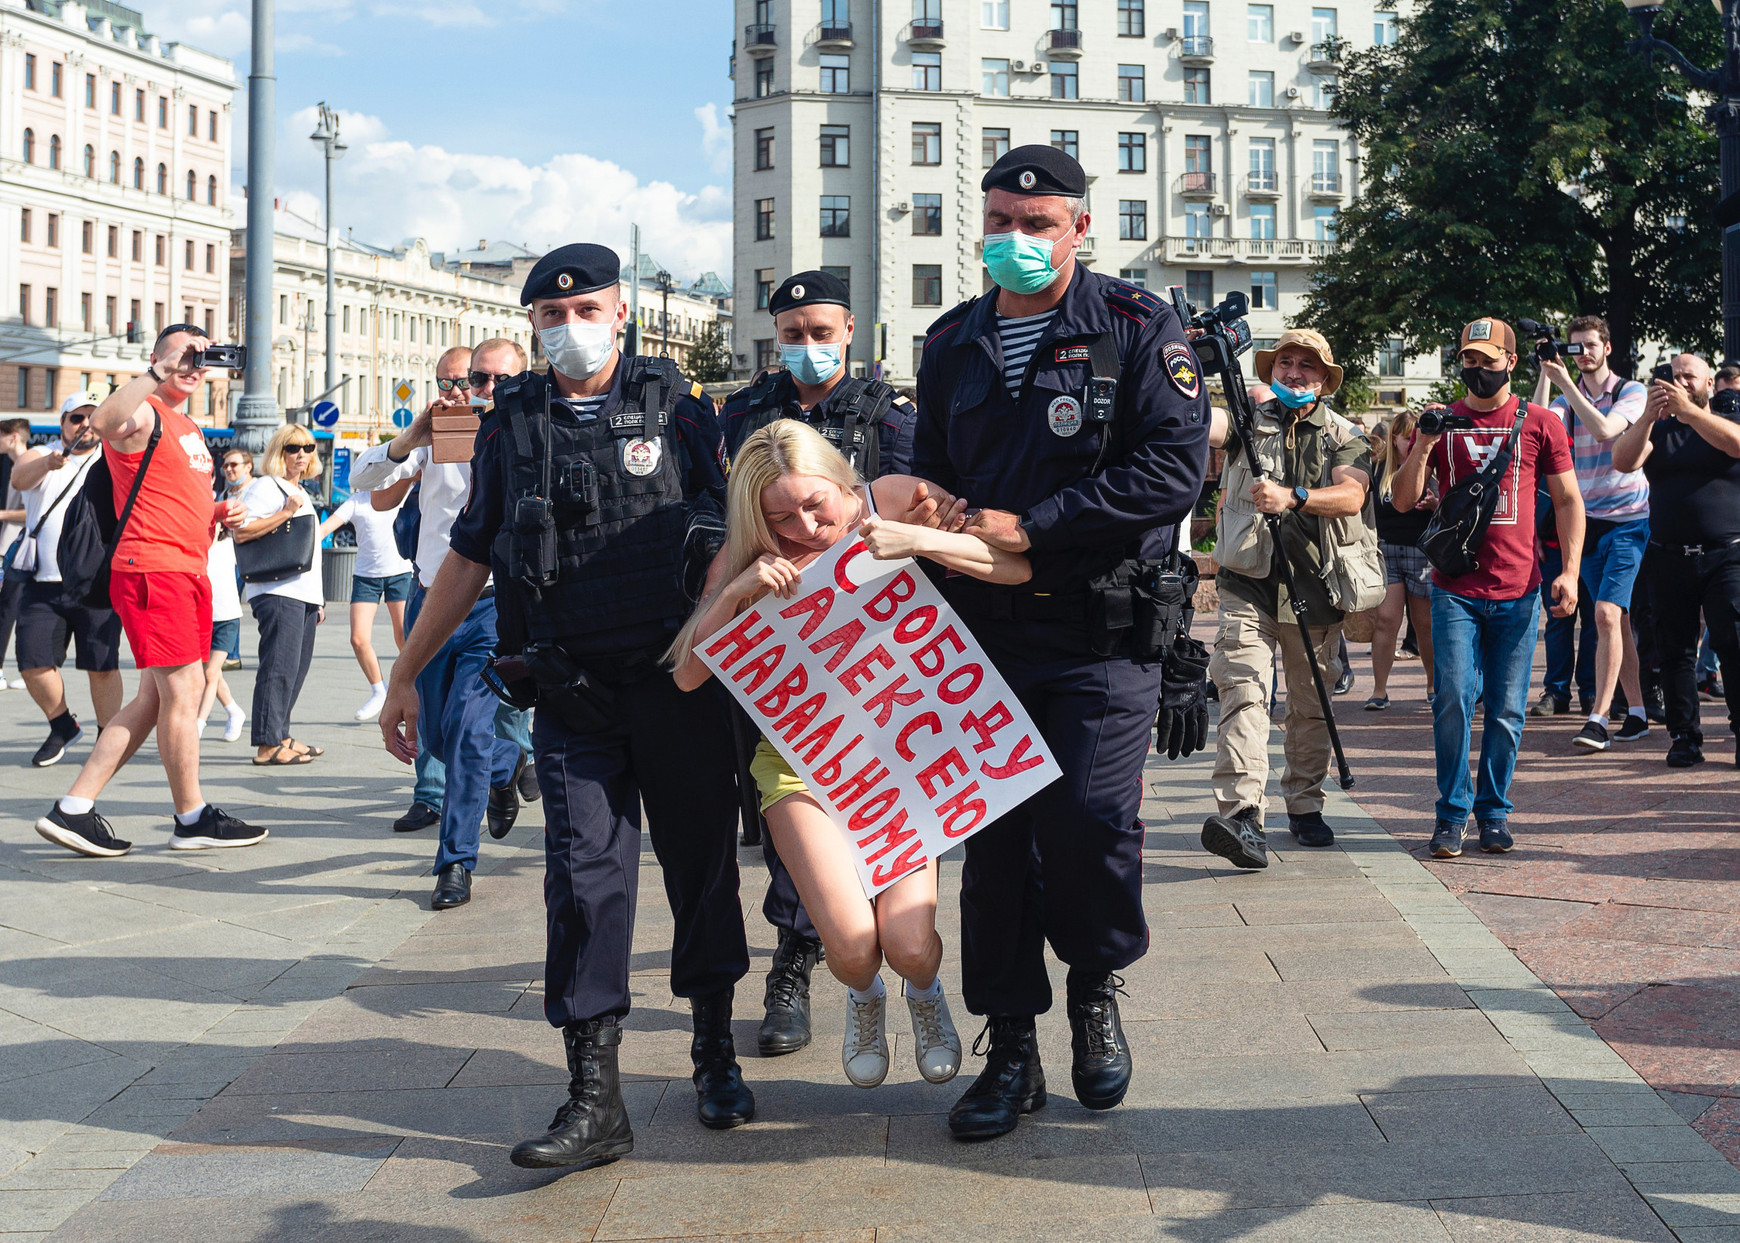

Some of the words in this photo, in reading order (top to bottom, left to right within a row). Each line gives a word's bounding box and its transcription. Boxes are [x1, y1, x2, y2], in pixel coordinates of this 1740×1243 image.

[1059, 350, 1067, 359] 2
[1170, 355, 1192, 367] РОССИЯ
[1093, 397, 1111, 405] DOZOR
[615, 416, 623, 425] 2
[821, 428, 828, 436] 2
[834, 541, 1045, 780] СВОБОДУ
[779, 586, 987, 838] АЛЕКСЕЮ
[705, 610, 928, 887] НАВАЛЬНОМУ
